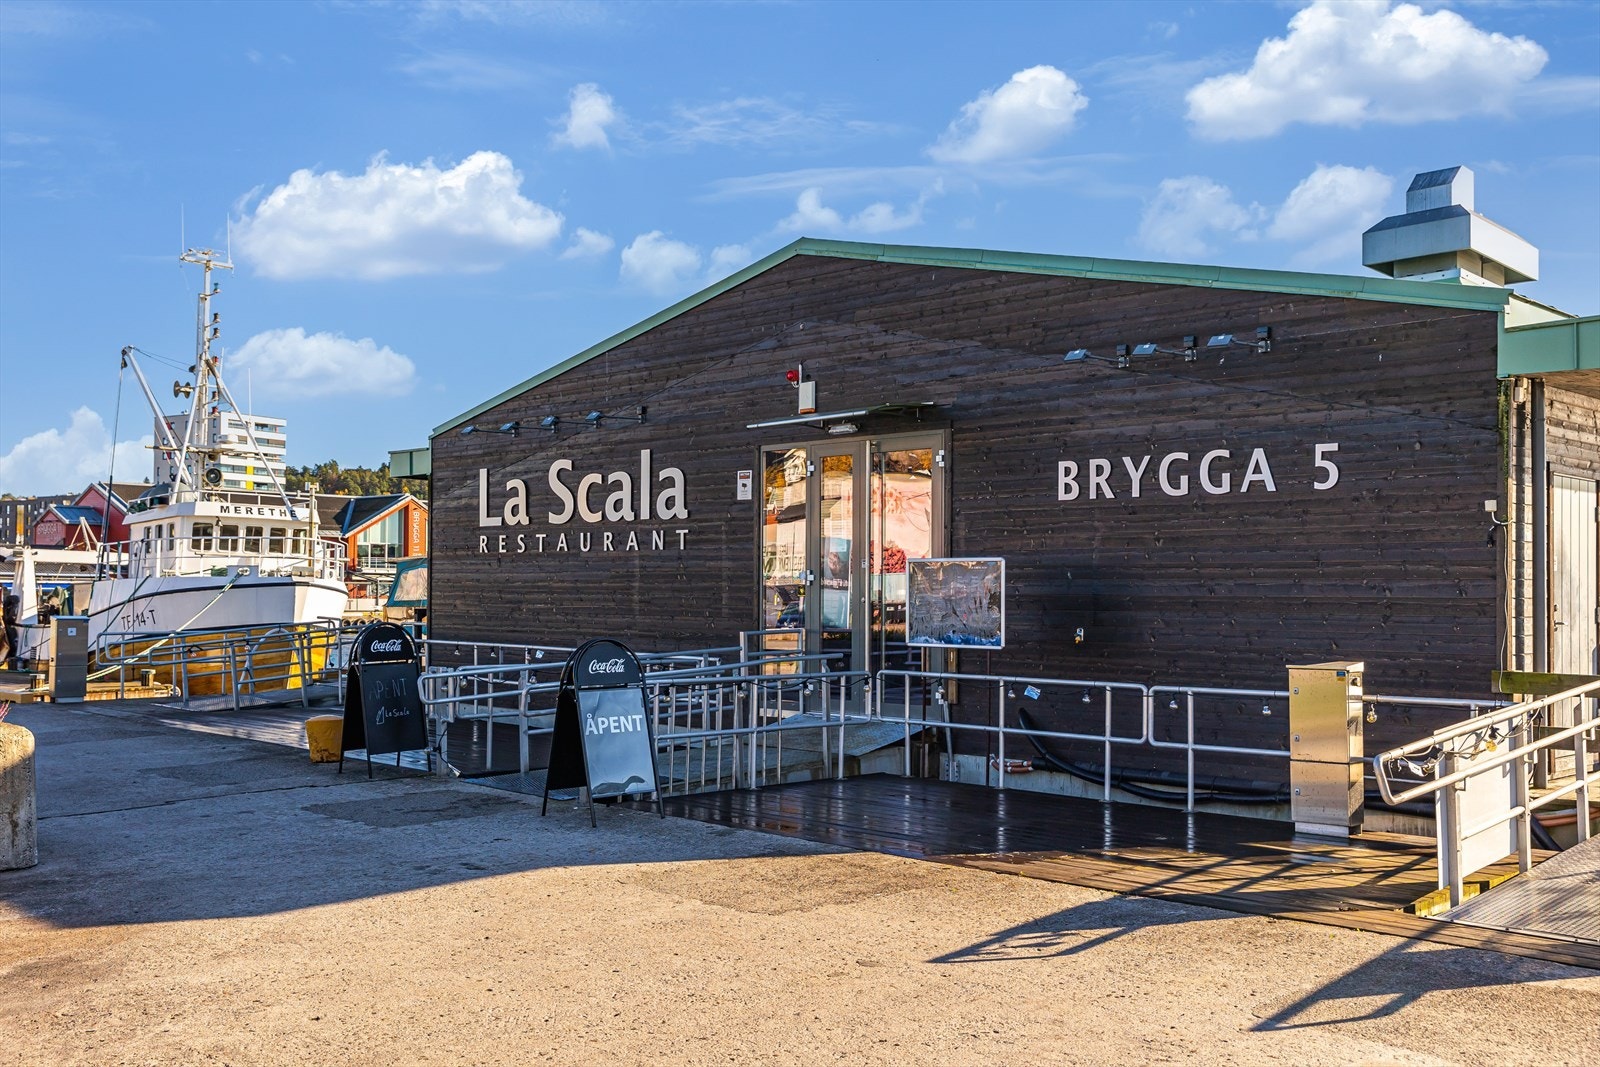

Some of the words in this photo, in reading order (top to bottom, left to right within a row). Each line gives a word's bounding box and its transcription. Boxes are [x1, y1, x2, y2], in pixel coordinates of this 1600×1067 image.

[1057, 447, 1278, 501] BRYGGA
[1313, 442, 1339, 490] 5
[479, 468, 530, 527] La
[548, 448, 689, 525] Scala
[220, 505, 297, 518] MERETHE
[478, 529, 689, 553] RESTAURANT
[585, 712, 643, 736] ÅPENT
